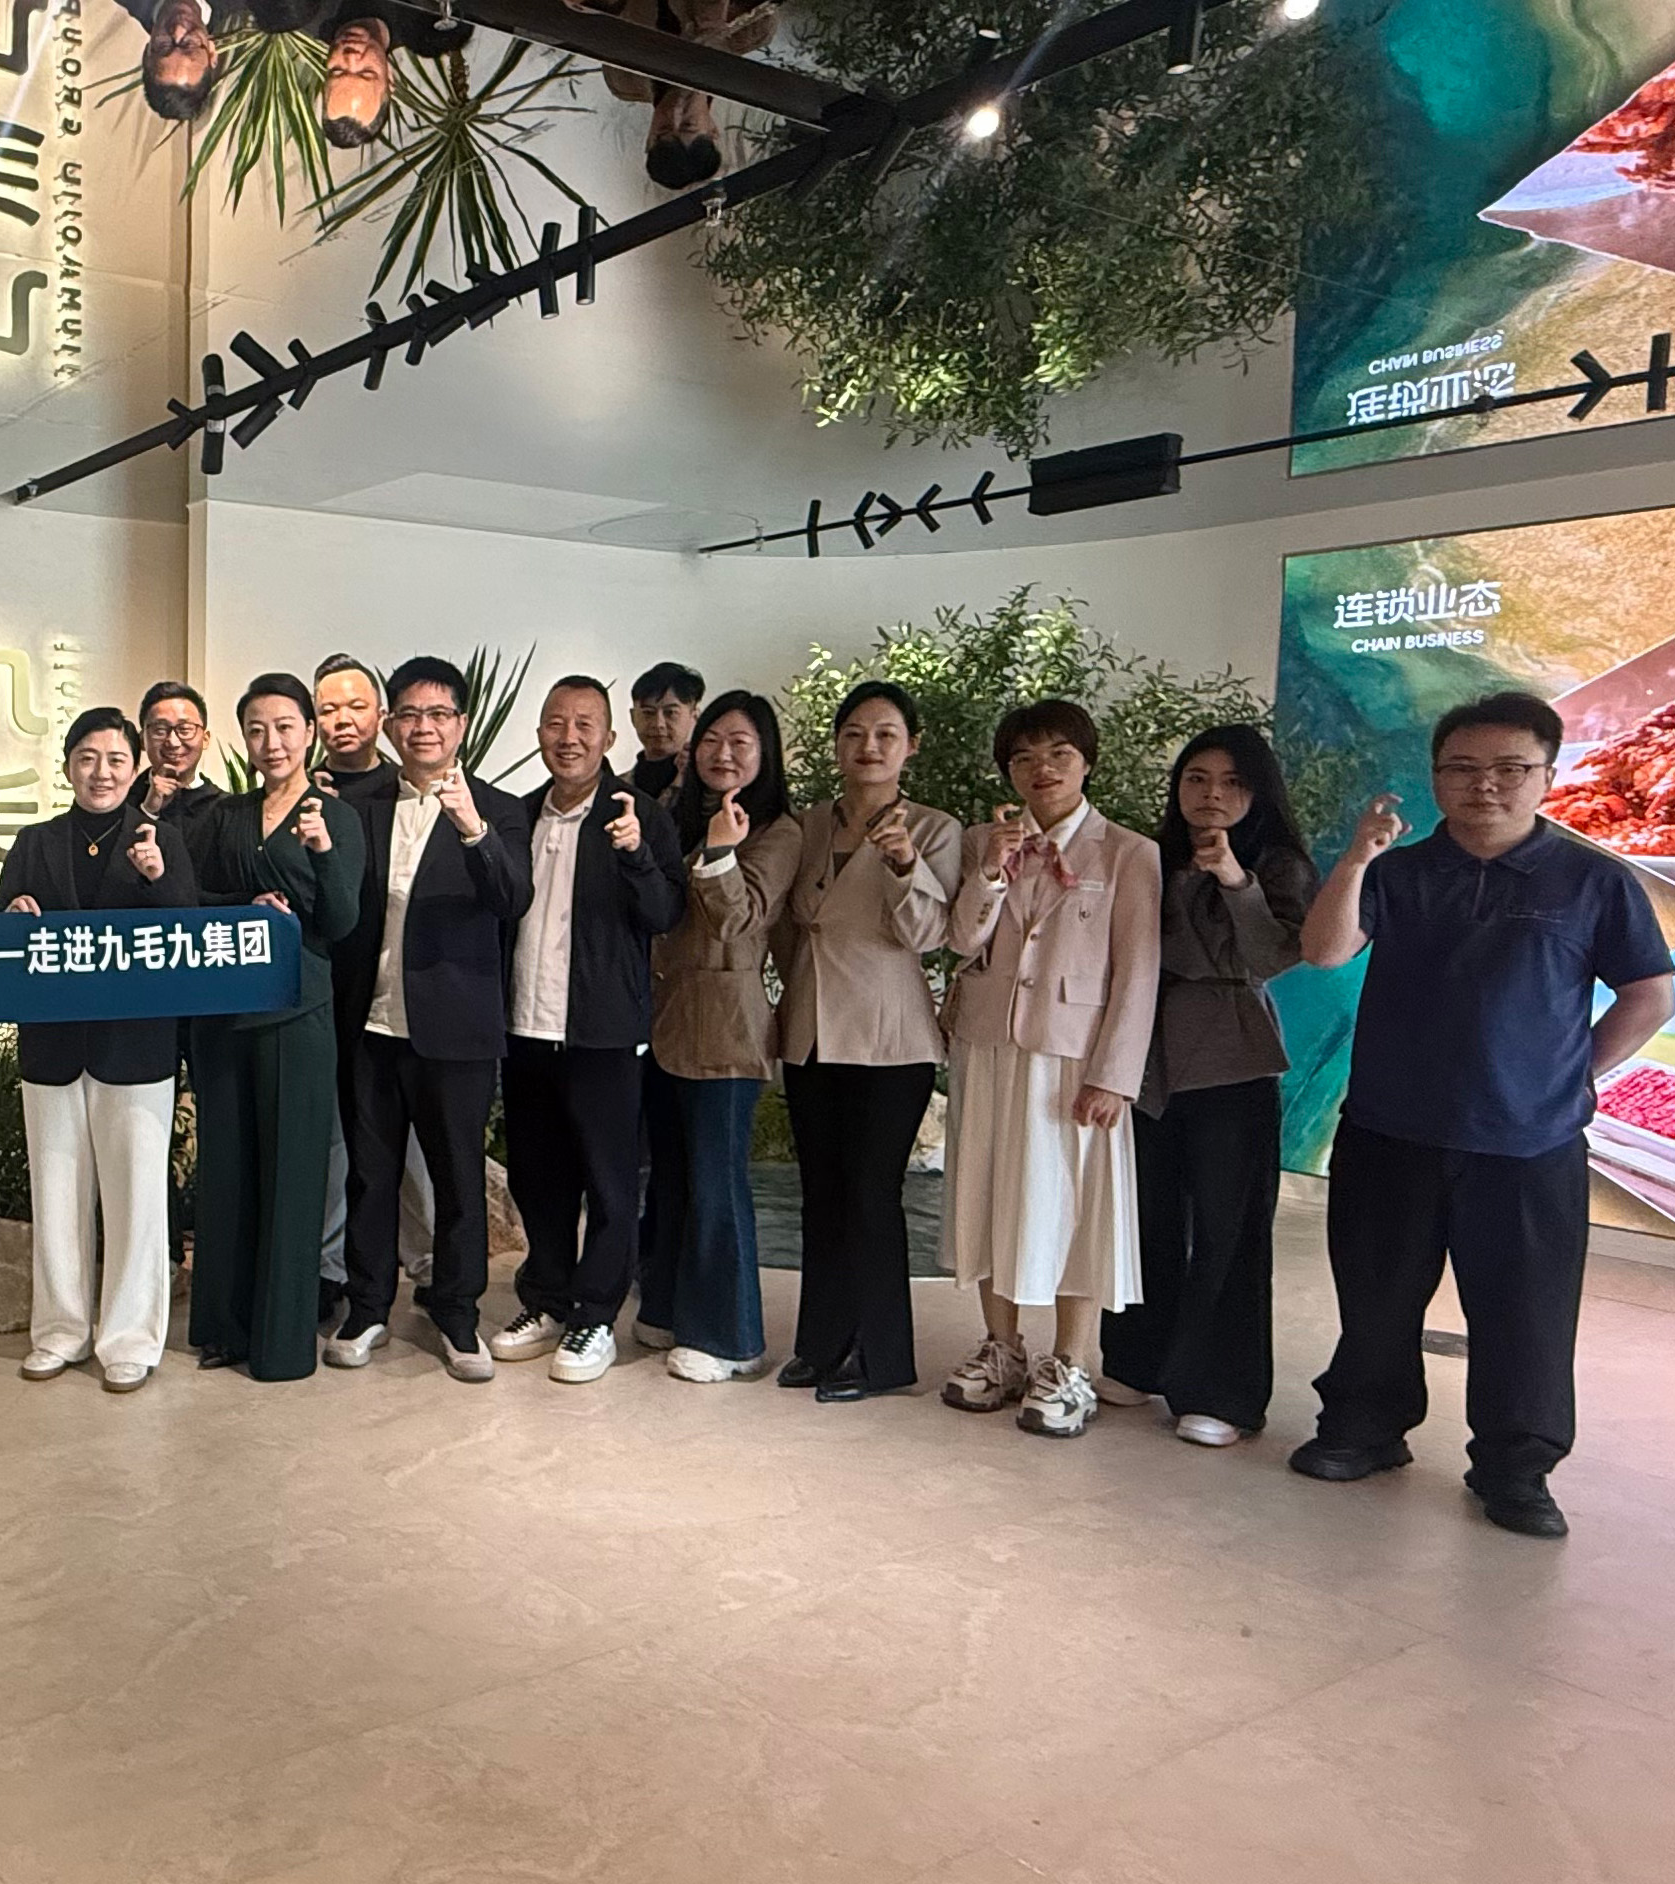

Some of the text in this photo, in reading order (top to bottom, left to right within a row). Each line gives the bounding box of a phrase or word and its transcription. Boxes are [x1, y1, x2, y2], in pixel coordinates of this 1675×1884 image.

[1333, 579, 1502, 628] 连锁业态
[1351, 630, 1484, 653] CHAIN BUSINESS
